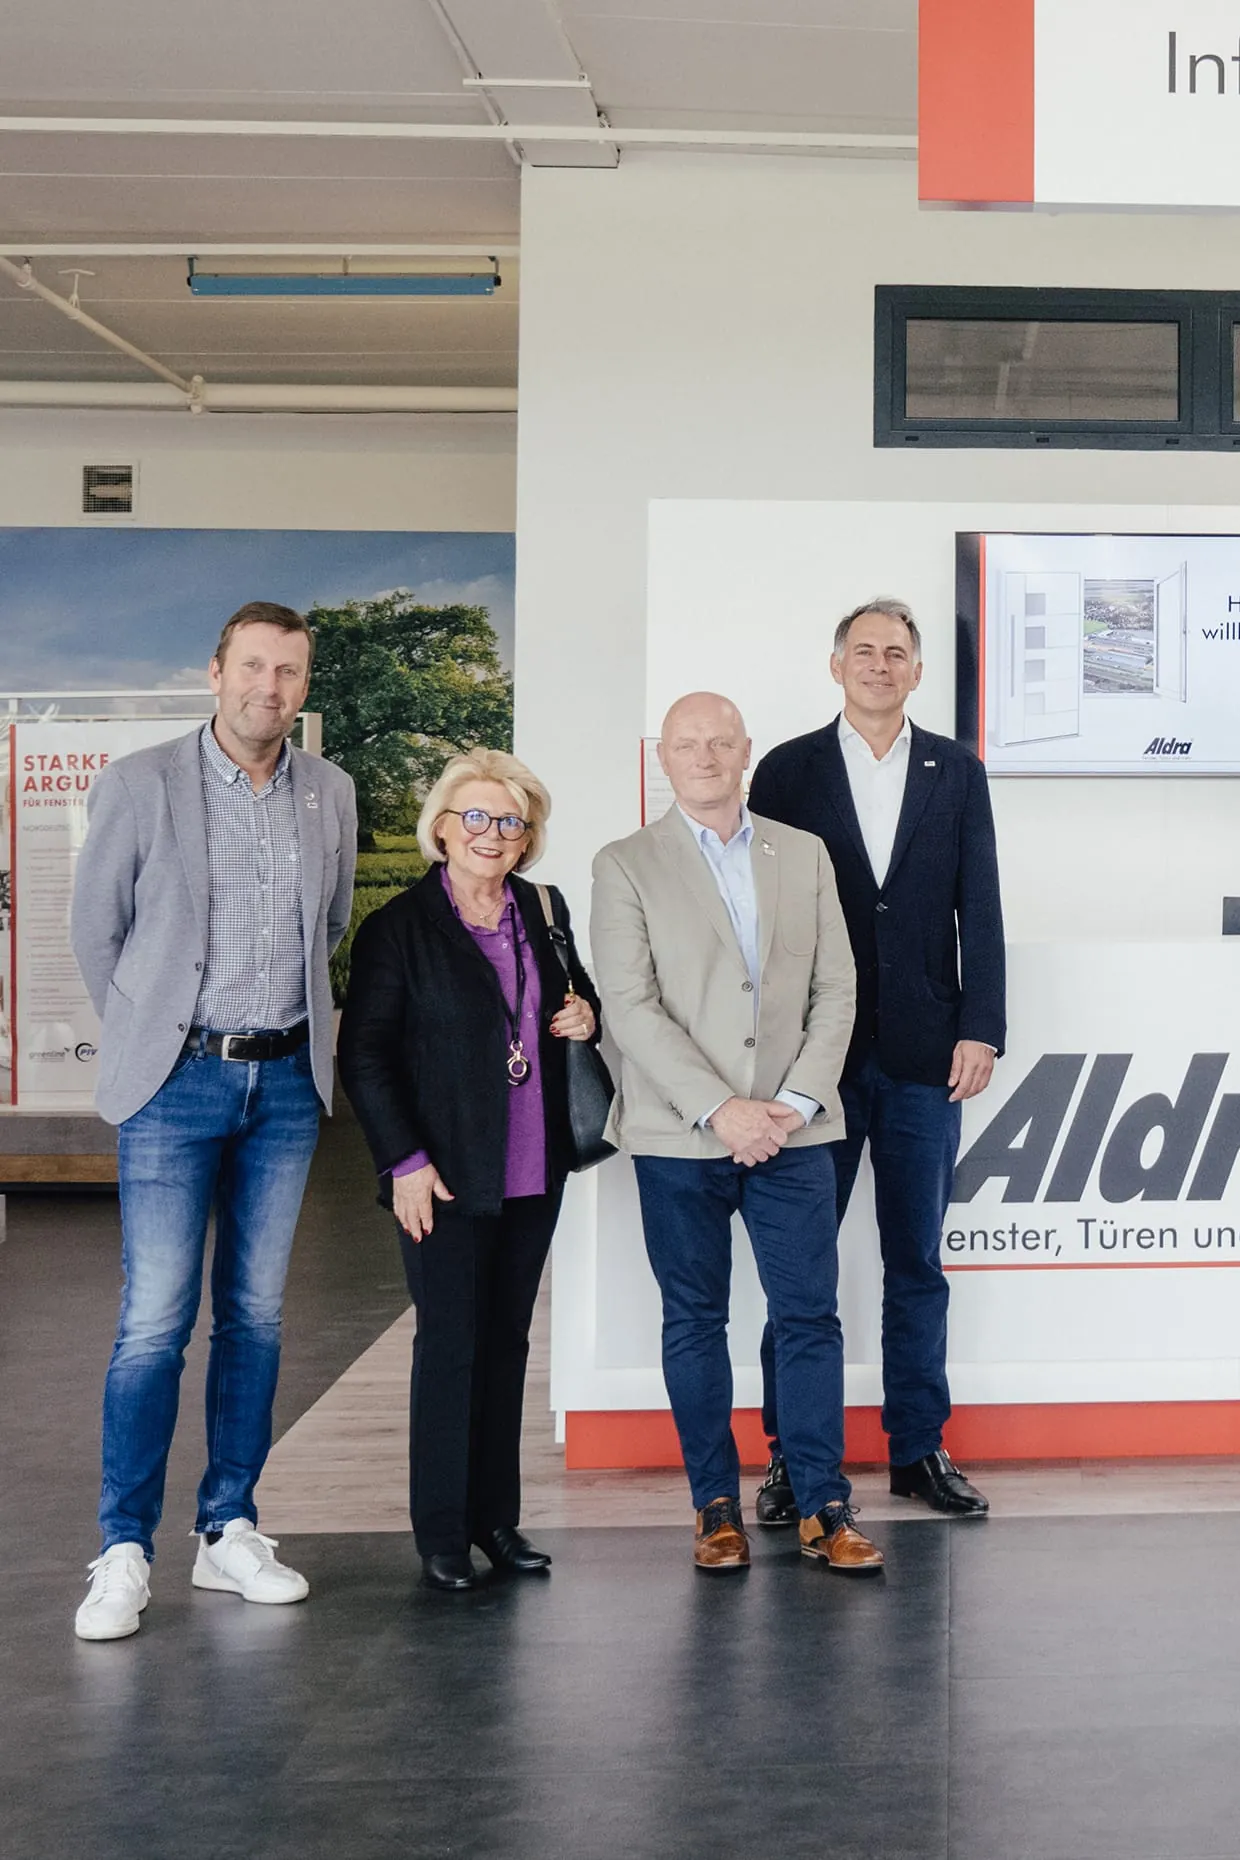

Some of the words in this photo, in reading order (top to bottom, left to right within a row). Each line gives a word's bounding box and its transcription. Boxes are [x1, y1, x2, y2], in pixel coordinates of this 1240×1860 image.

[1143, 737, 1193, 755] Aldra
[23, 774, 98, 793] ARGU
[23, 797, 41, 808] FÜR
[941, 1222, 1062, 1257] enster,
[1077, 1218, 1177, 1249] Türen
